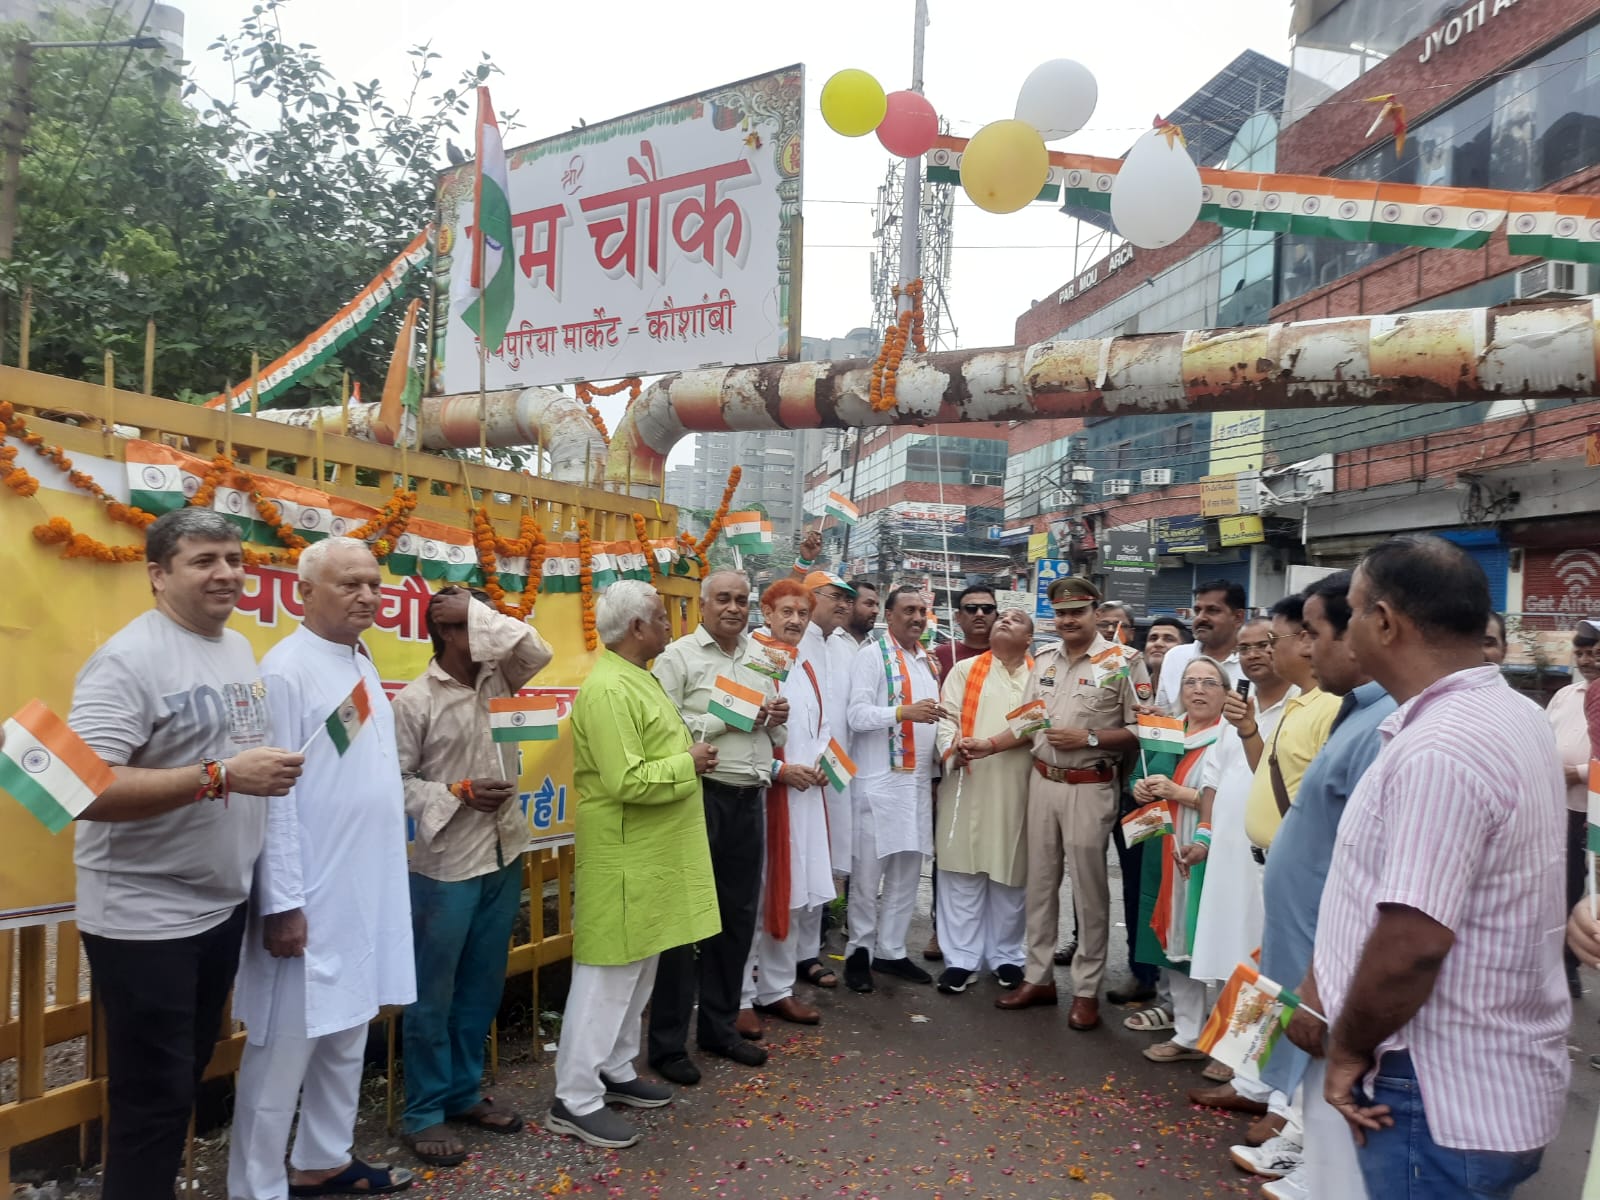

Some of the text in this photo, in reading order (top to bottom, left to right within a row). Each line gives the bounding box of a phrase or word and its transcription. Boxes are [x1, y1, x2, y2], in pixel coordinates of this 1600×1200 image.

[1419, 0, 1485, 64] JYOTI
[579, 140, 752, 278] चौक
[475, 320, 558, 370] पुरिया
[562, 307, 622, 349] मार्केट
[646, 288, 737, 344] कौशांबी
[375, 573, 431, 641] चौ
[1526, 595, 1600, 612] Get Airte
